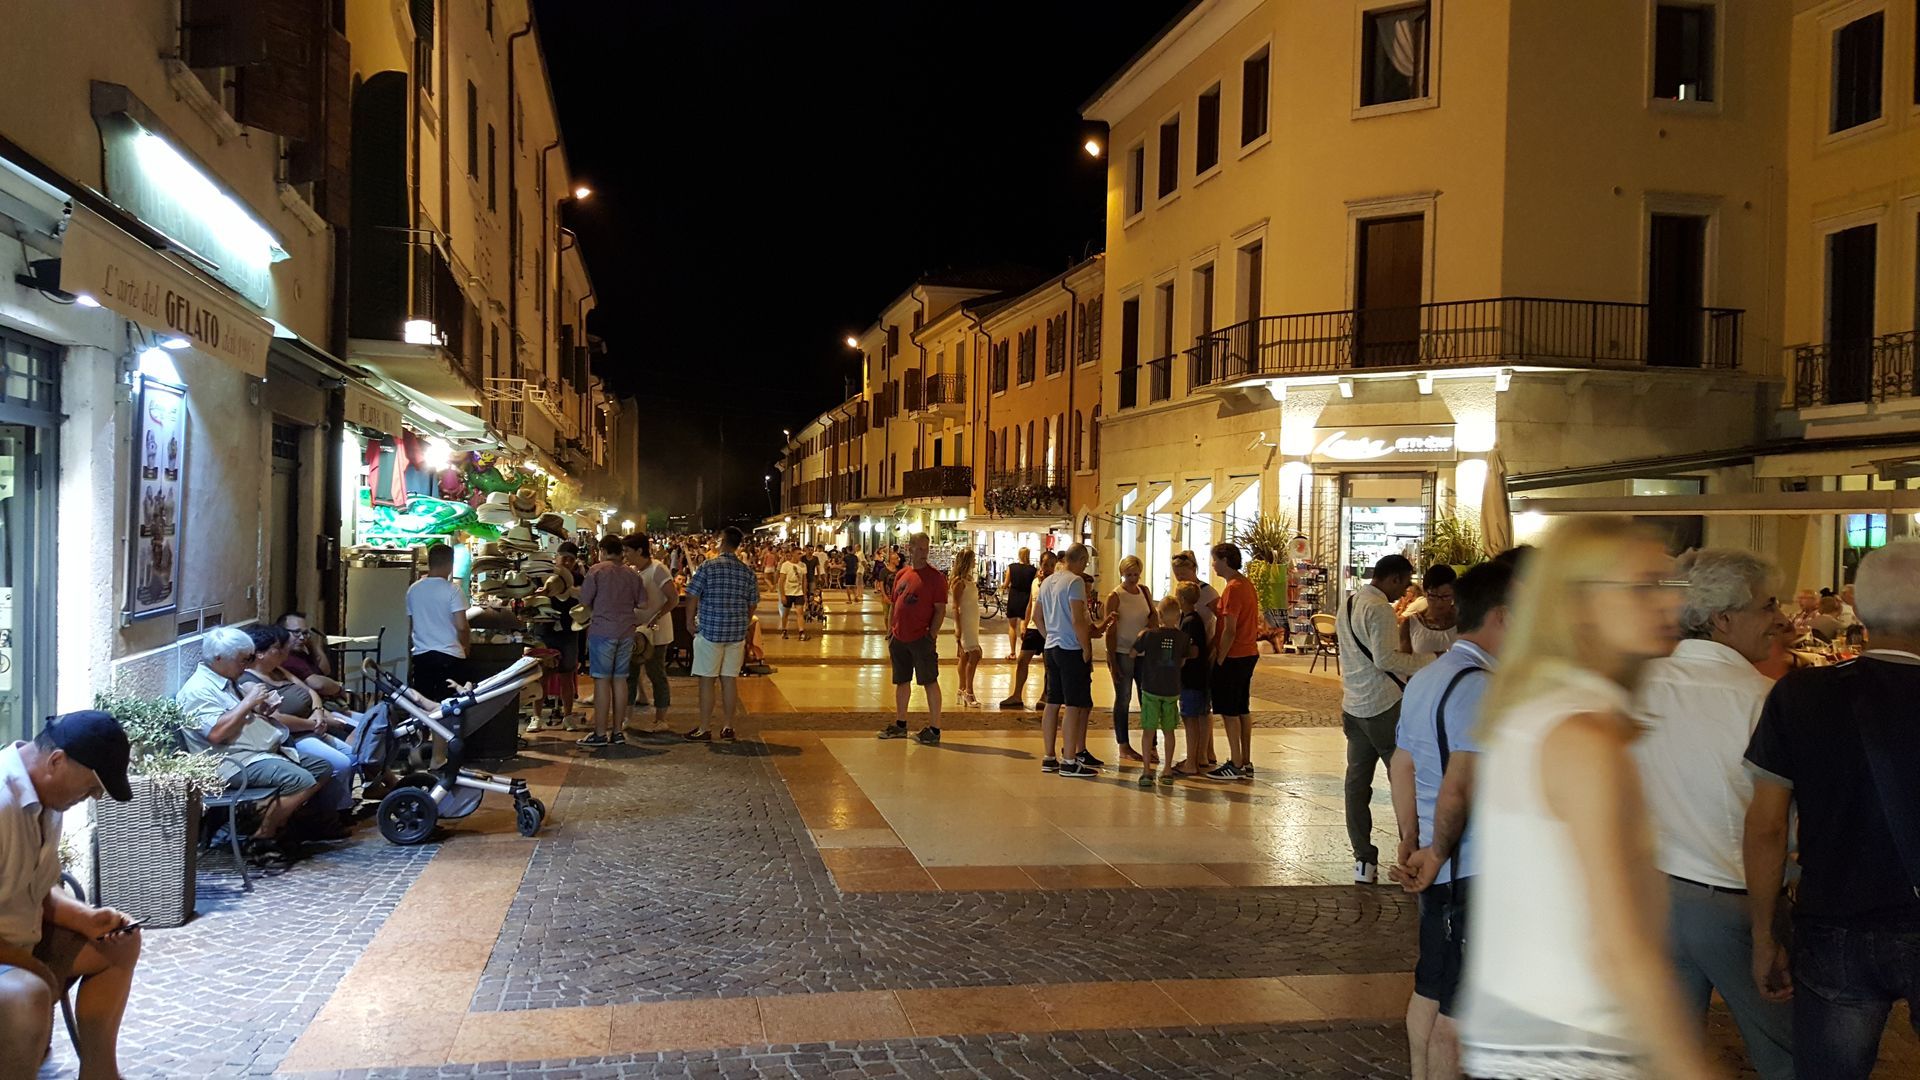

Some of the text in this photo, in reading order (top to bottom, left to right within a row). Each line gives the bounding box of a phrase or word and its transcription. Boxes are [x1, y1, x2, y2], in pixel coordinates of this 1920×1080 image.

[101, 264, 139, 309] L'arte
[142, 280, 160, 318] del
[165, 290, 220, 349] GELATO
